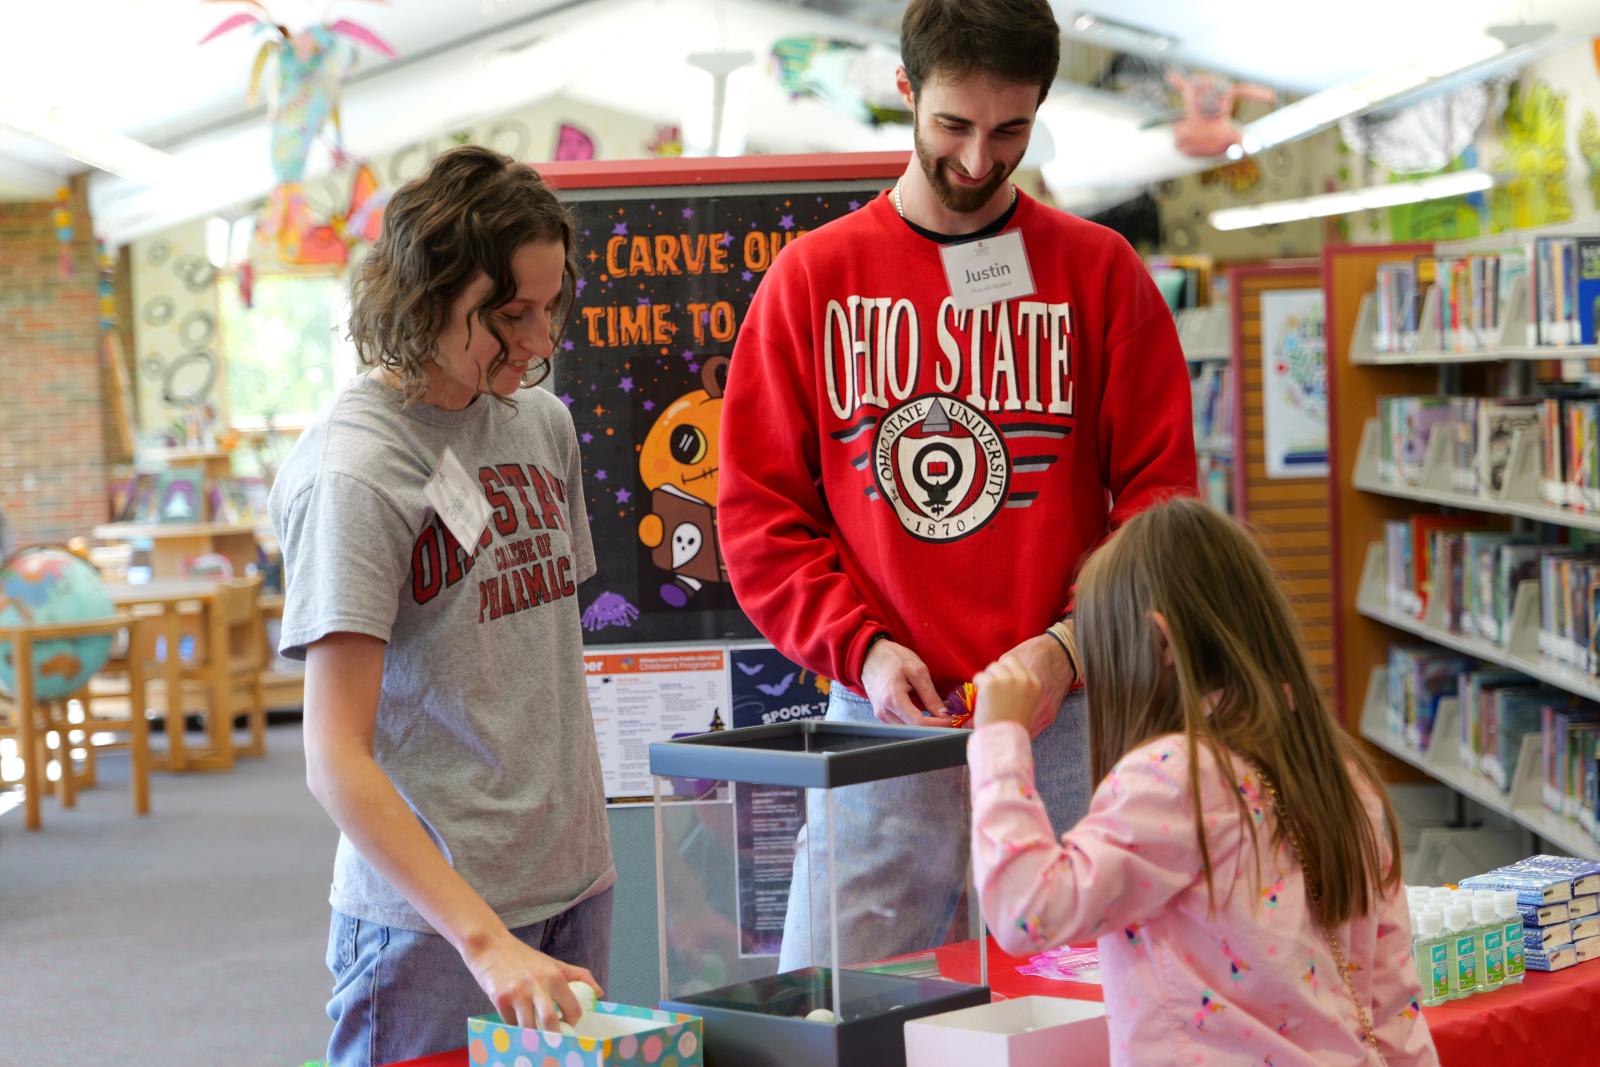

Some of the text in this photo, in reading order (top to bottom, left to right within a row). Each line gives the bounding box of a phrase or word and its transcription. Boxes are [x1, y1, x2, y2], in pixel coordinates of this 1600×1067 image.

[606, 230, 809, 278] CARVE OU
[965, 262, 1011, 284] Justin
[582, 301, 736, 347] TIME TO
[823, 294, 1075, 420] OHIO STATE
[884, 402, 926, 438] STATE
[878, 437, 893, 481] OHIO
[948, 402, 1004, 504] UNIVERSITY
[914, 519, 966, 537] 1870
[494, 532, 553, 572] COLLEGE OF
